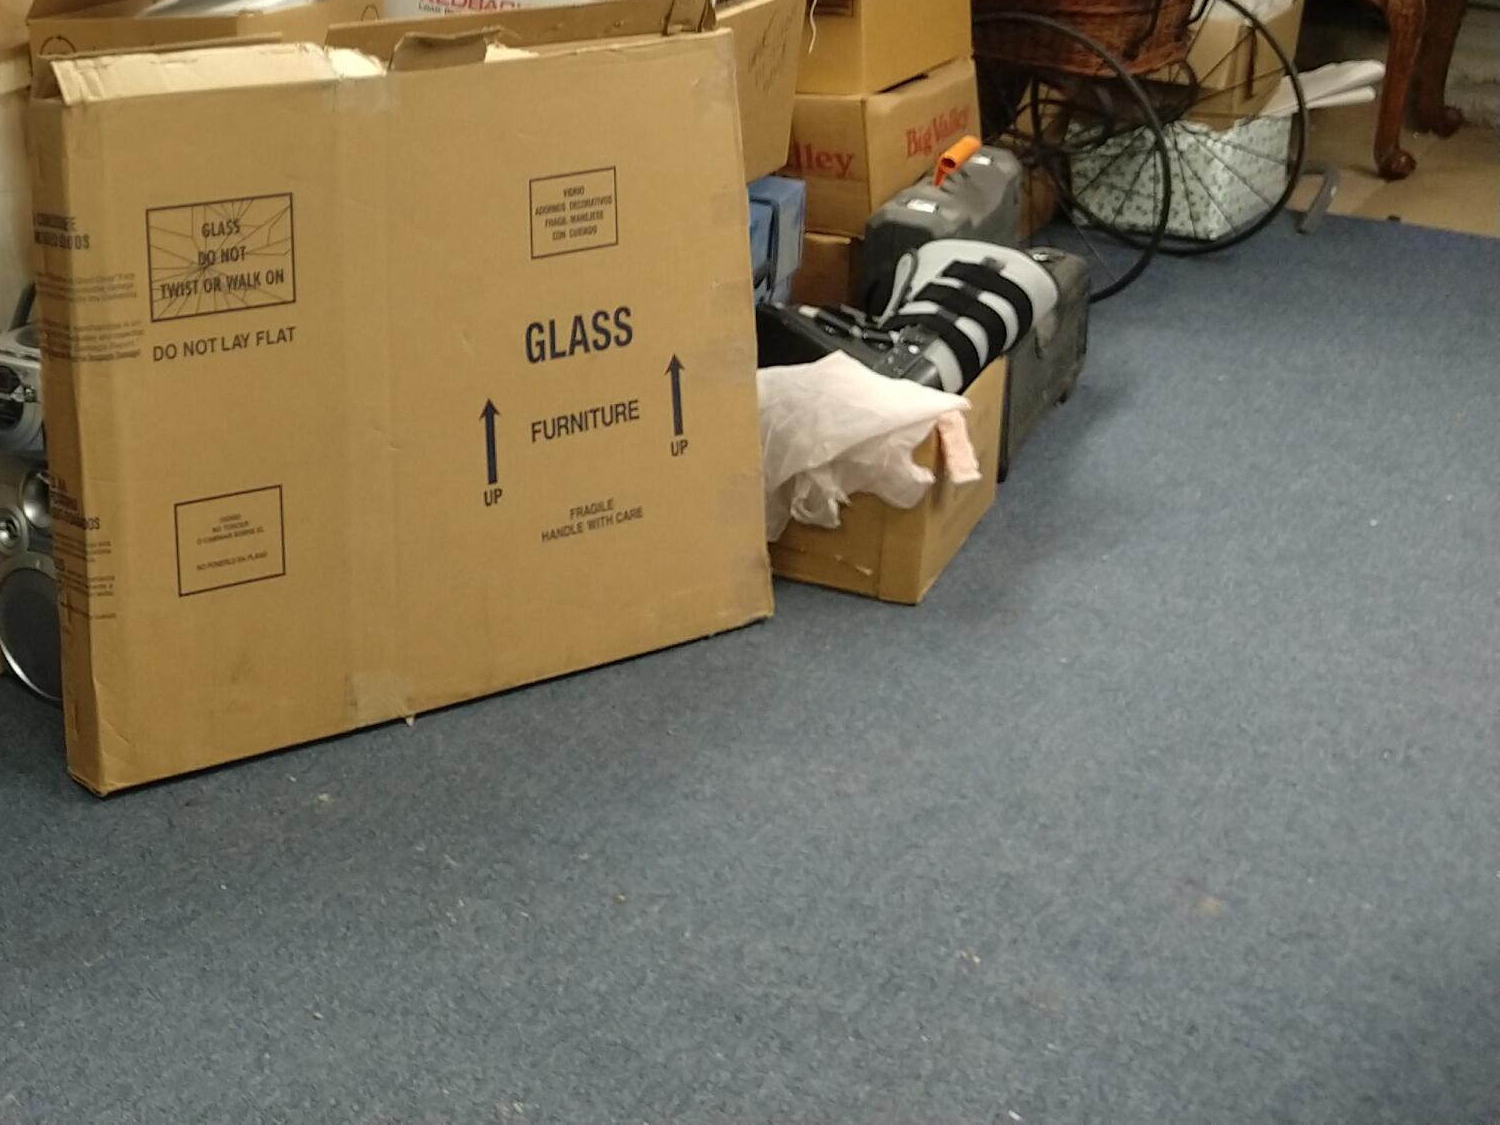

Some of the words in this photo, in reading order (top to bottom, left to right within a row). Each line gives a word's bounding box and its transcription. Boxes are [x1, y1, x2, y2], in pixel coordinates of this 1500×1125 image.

[790, 140, 854, 175] lley
[201, 218, 242, 239] GLASS
[197, 249, 217, 267] DO
[220, 245, 247, 264] NOT
[159, 279, 200, 300] TWIST
[203, 277, 222, 294] OR
[226, 271, 262, 291] WALK
[265, 268, 285, 285] ON
[152, 343, 178, 363] DO
[183, 336, 218, 358] NOT
[220, 331, 251, 352] LAY
[255, 325, 297, 347] FLAT
[525, 306, 634, 364] GLASS
[530, 399, 641, 444] FURNITURE
[670, 438, 689, 457] UP
[483, 487, 503, 507] UP
[569, 498, 615, 520] FRAGILE
[540, 521, 584, 543] HANDLE
[586, 514, 614, 533] WITH
[615, 506, 645, 524] CARE
